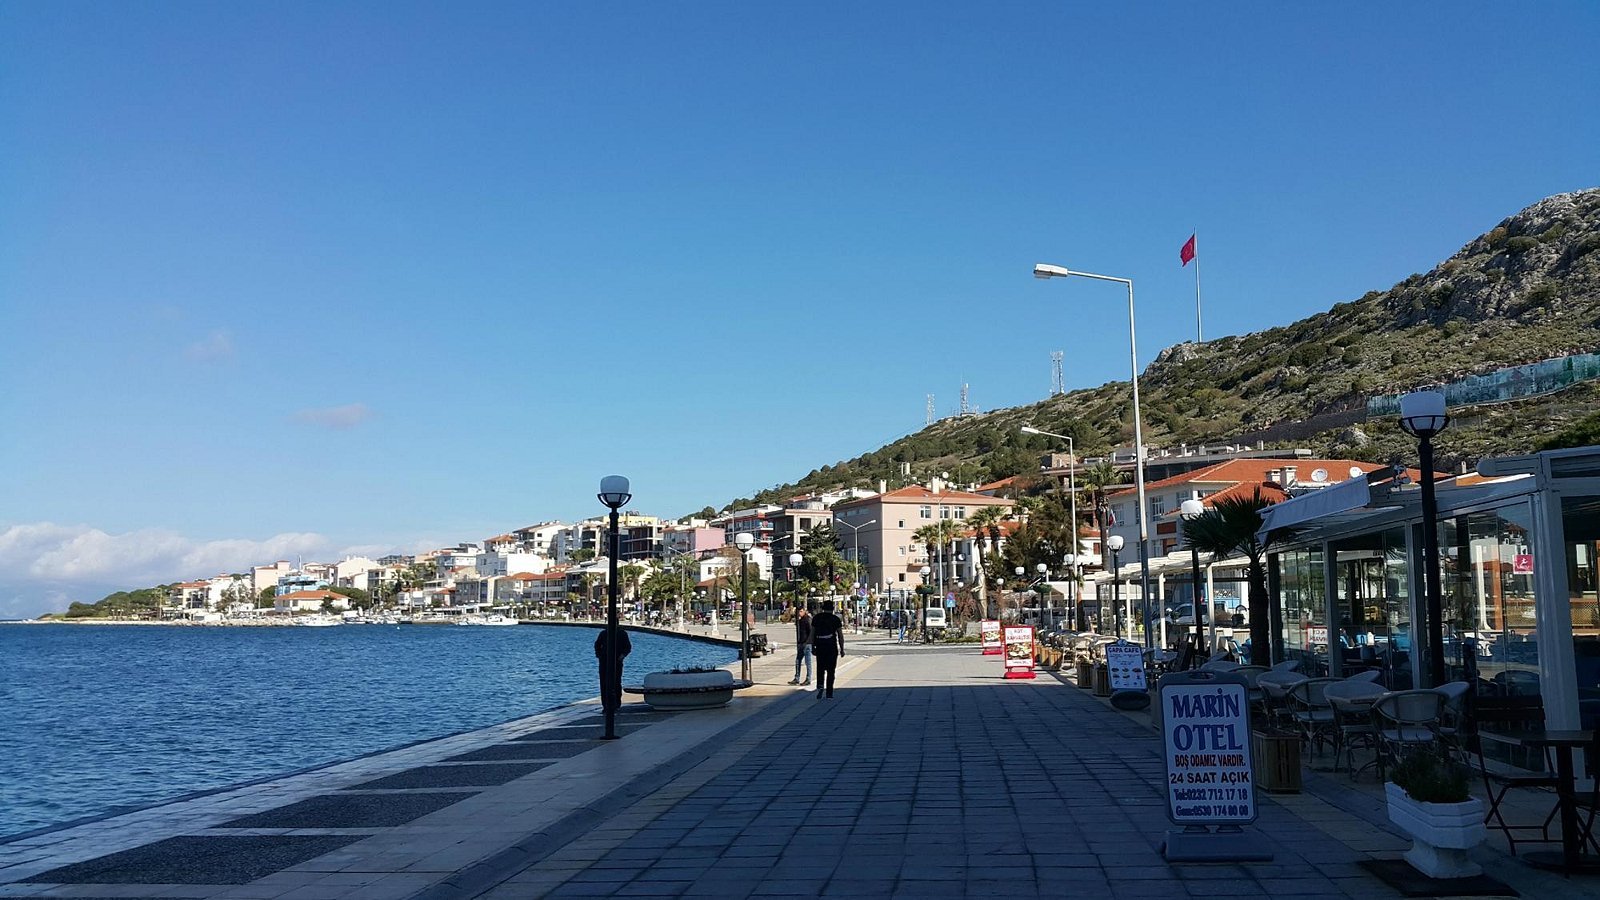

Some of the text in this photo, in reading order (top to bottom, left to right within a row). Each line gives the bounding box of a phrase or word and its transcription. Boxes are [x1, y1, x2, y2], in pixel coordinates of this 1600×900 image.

[1171, 688, 1240, 718] MARİN
[1173, 723, 1243, 750] OTEL
[1175, 754, 1246, 770] BOŞ ODAMIZ VARDIR.
[1170, 771, 1250, 785] 24 SAAT AÇIK
[1207, 788, 1224, 800] 712
[1225, 788, 1236, 800] 17
[1237, 788, 1248, 800] 18
[1213, 805, 1227, 816] 174
